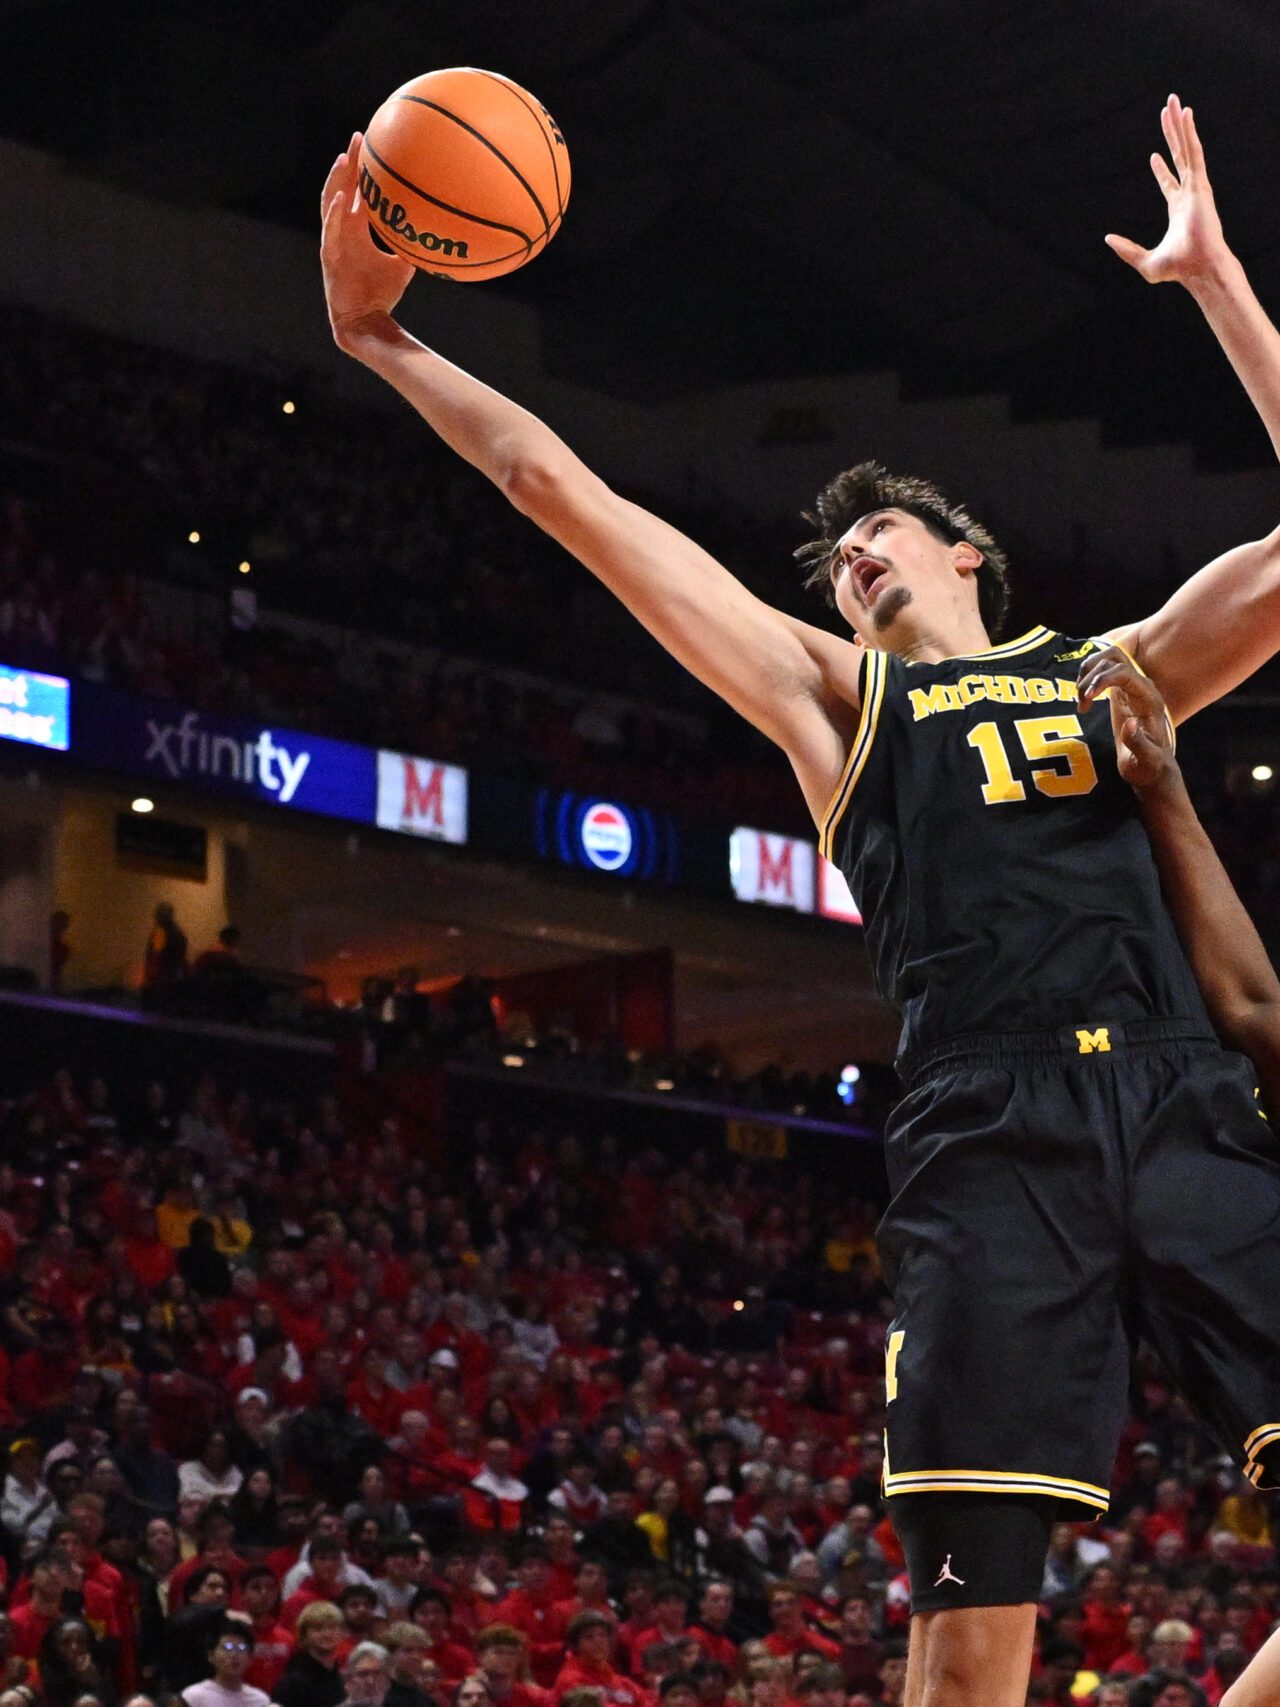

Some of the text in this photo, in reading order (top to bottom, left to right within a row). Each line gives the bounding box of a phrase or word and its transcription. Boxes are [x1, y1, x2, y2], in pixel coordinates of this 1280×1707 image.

[361, 163, 468, 258] Wilson
[146, 711, 310, 802] xfinity
[402, 757, 444, 826] M
[967, 714, 1099, 805] 15
[758, 832, 793, 897] M
[1075, 1028, 1111, 1054] M
